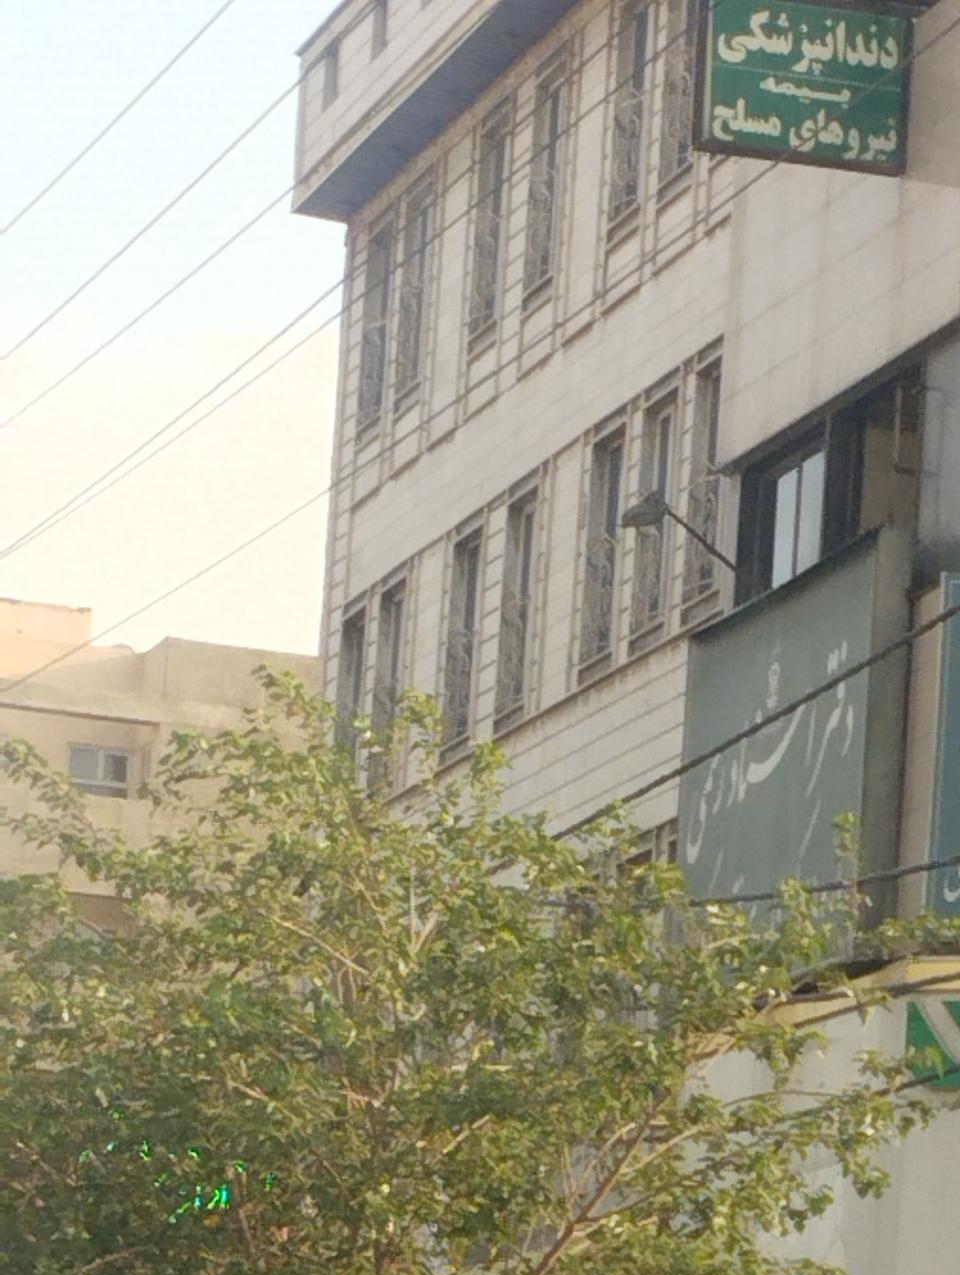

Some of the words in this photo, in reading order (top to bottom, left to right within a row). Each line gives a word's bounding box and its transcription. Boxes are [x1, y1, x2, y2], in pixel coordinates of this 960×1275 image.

[718, 10, 899, 75] دندانپزشکی
[759, 77, 851, 109] بیمه
[712, 97, 782, 141] مسلح
[788, 108, 898, 161] نیروهای
